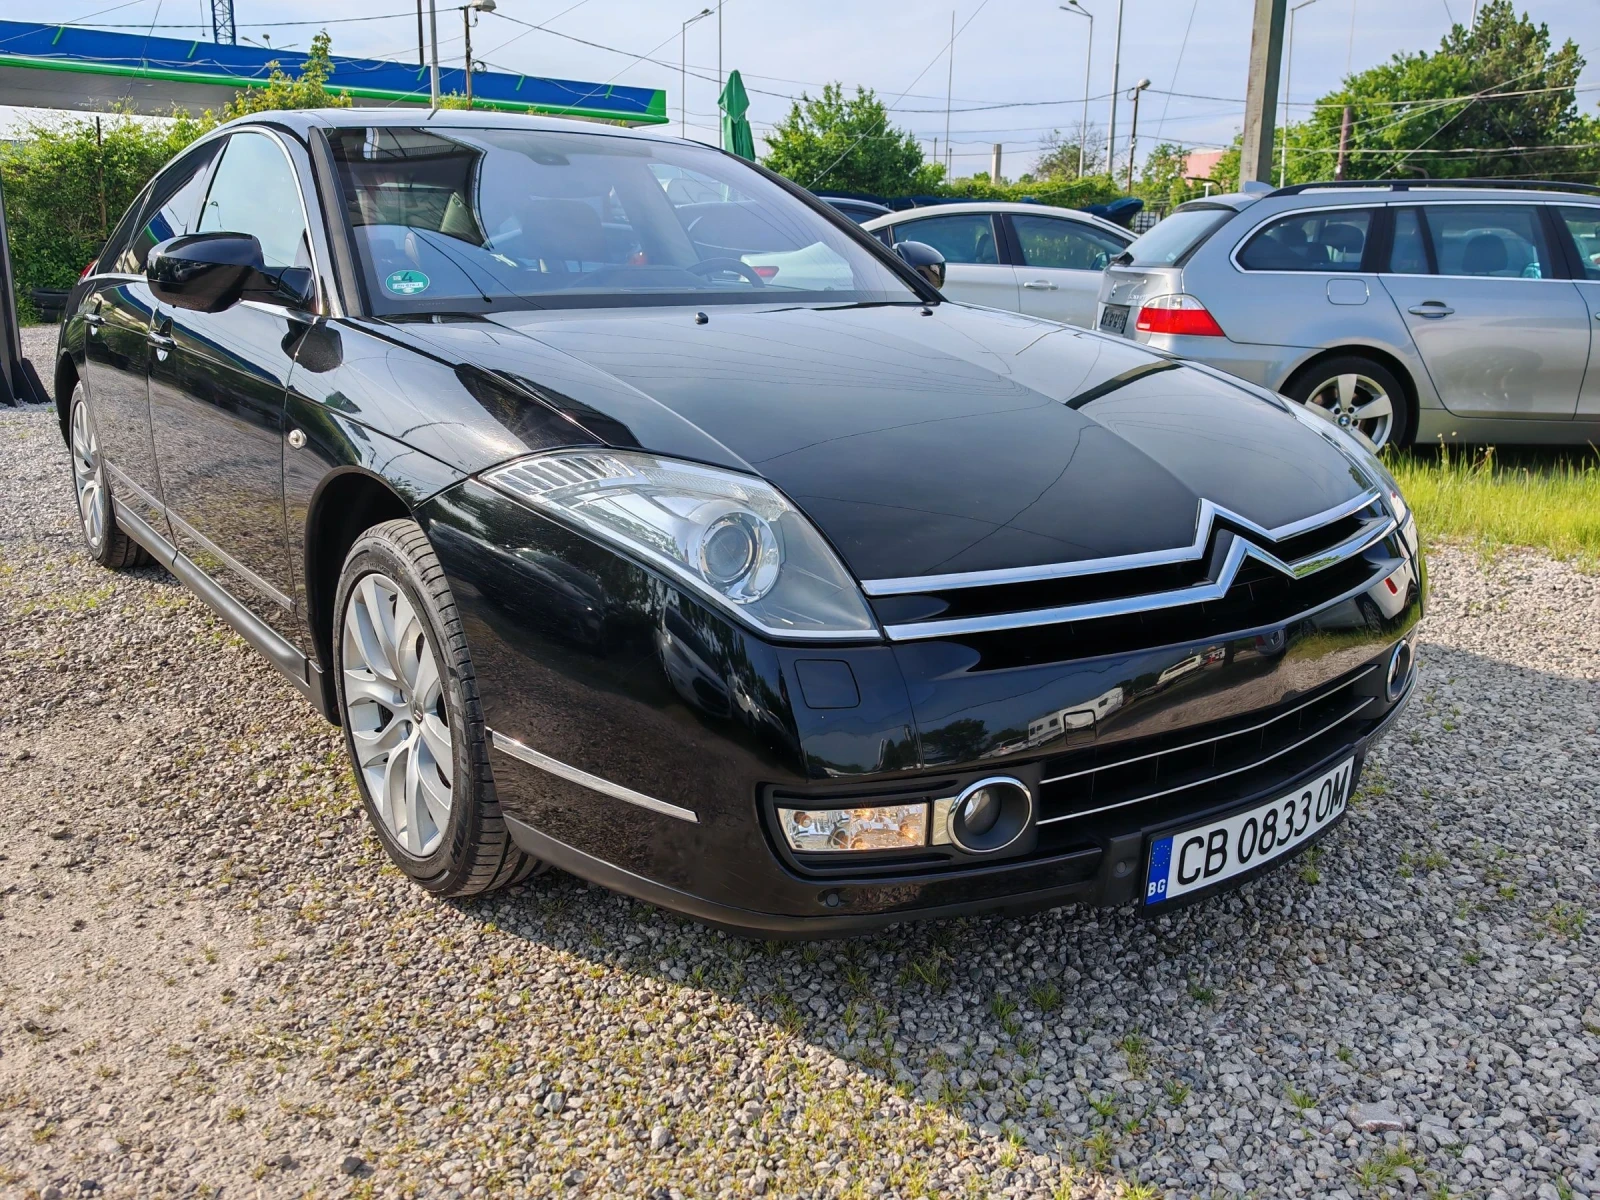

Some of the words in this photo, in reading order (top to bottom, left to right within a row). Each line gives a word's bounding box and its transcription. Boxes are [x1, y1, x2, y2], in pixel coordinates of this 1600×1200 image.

[402, 271, 414, 282] 4
[1176, 828, 1229, 886] CB
[1237, 790, 1312, 865] 0833
[1315, 765, 1349, 823] OM
[1147, 878, 1166, 897] BG
